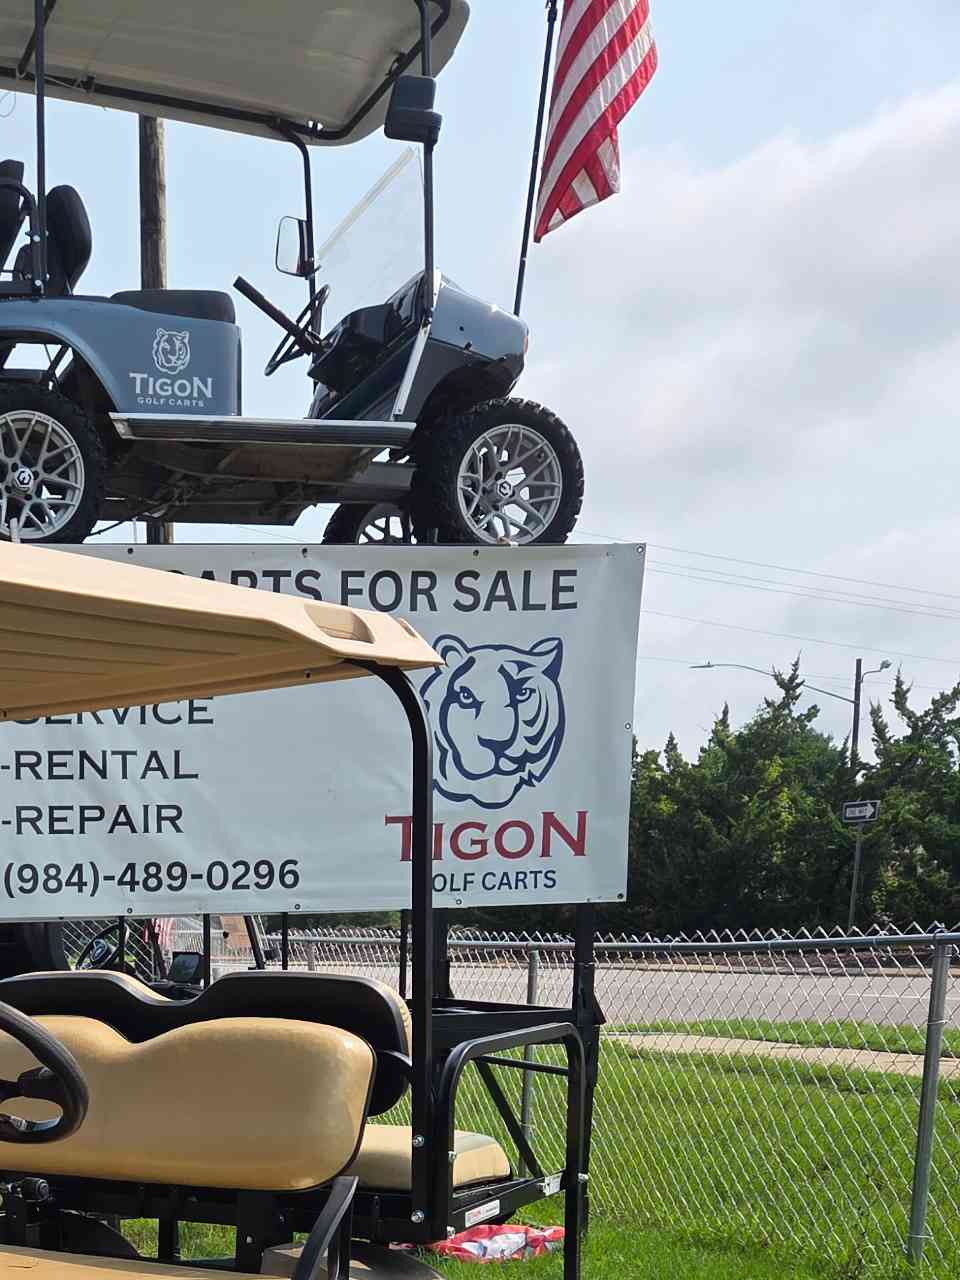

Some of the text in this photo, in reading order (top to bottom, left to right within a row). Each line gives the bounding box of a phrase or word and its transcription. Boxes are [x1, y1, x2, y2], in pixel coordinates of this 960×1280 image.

[128, 372, 213, 399] TIGON
[137, 396, 205, 408] GOLF CARTS
[341, 570, 438, 612] FOR
[452, 569, 578, 612] SALE
[0, 749, 200, 780] -RENTAL
[1, 804, 185, 835] -REPAIR
[384, 810, 589, 862] TIGON
[3, 859, 301, 899] (984)-489-0296
[432, 869, 558, 893] OLF CARTS
